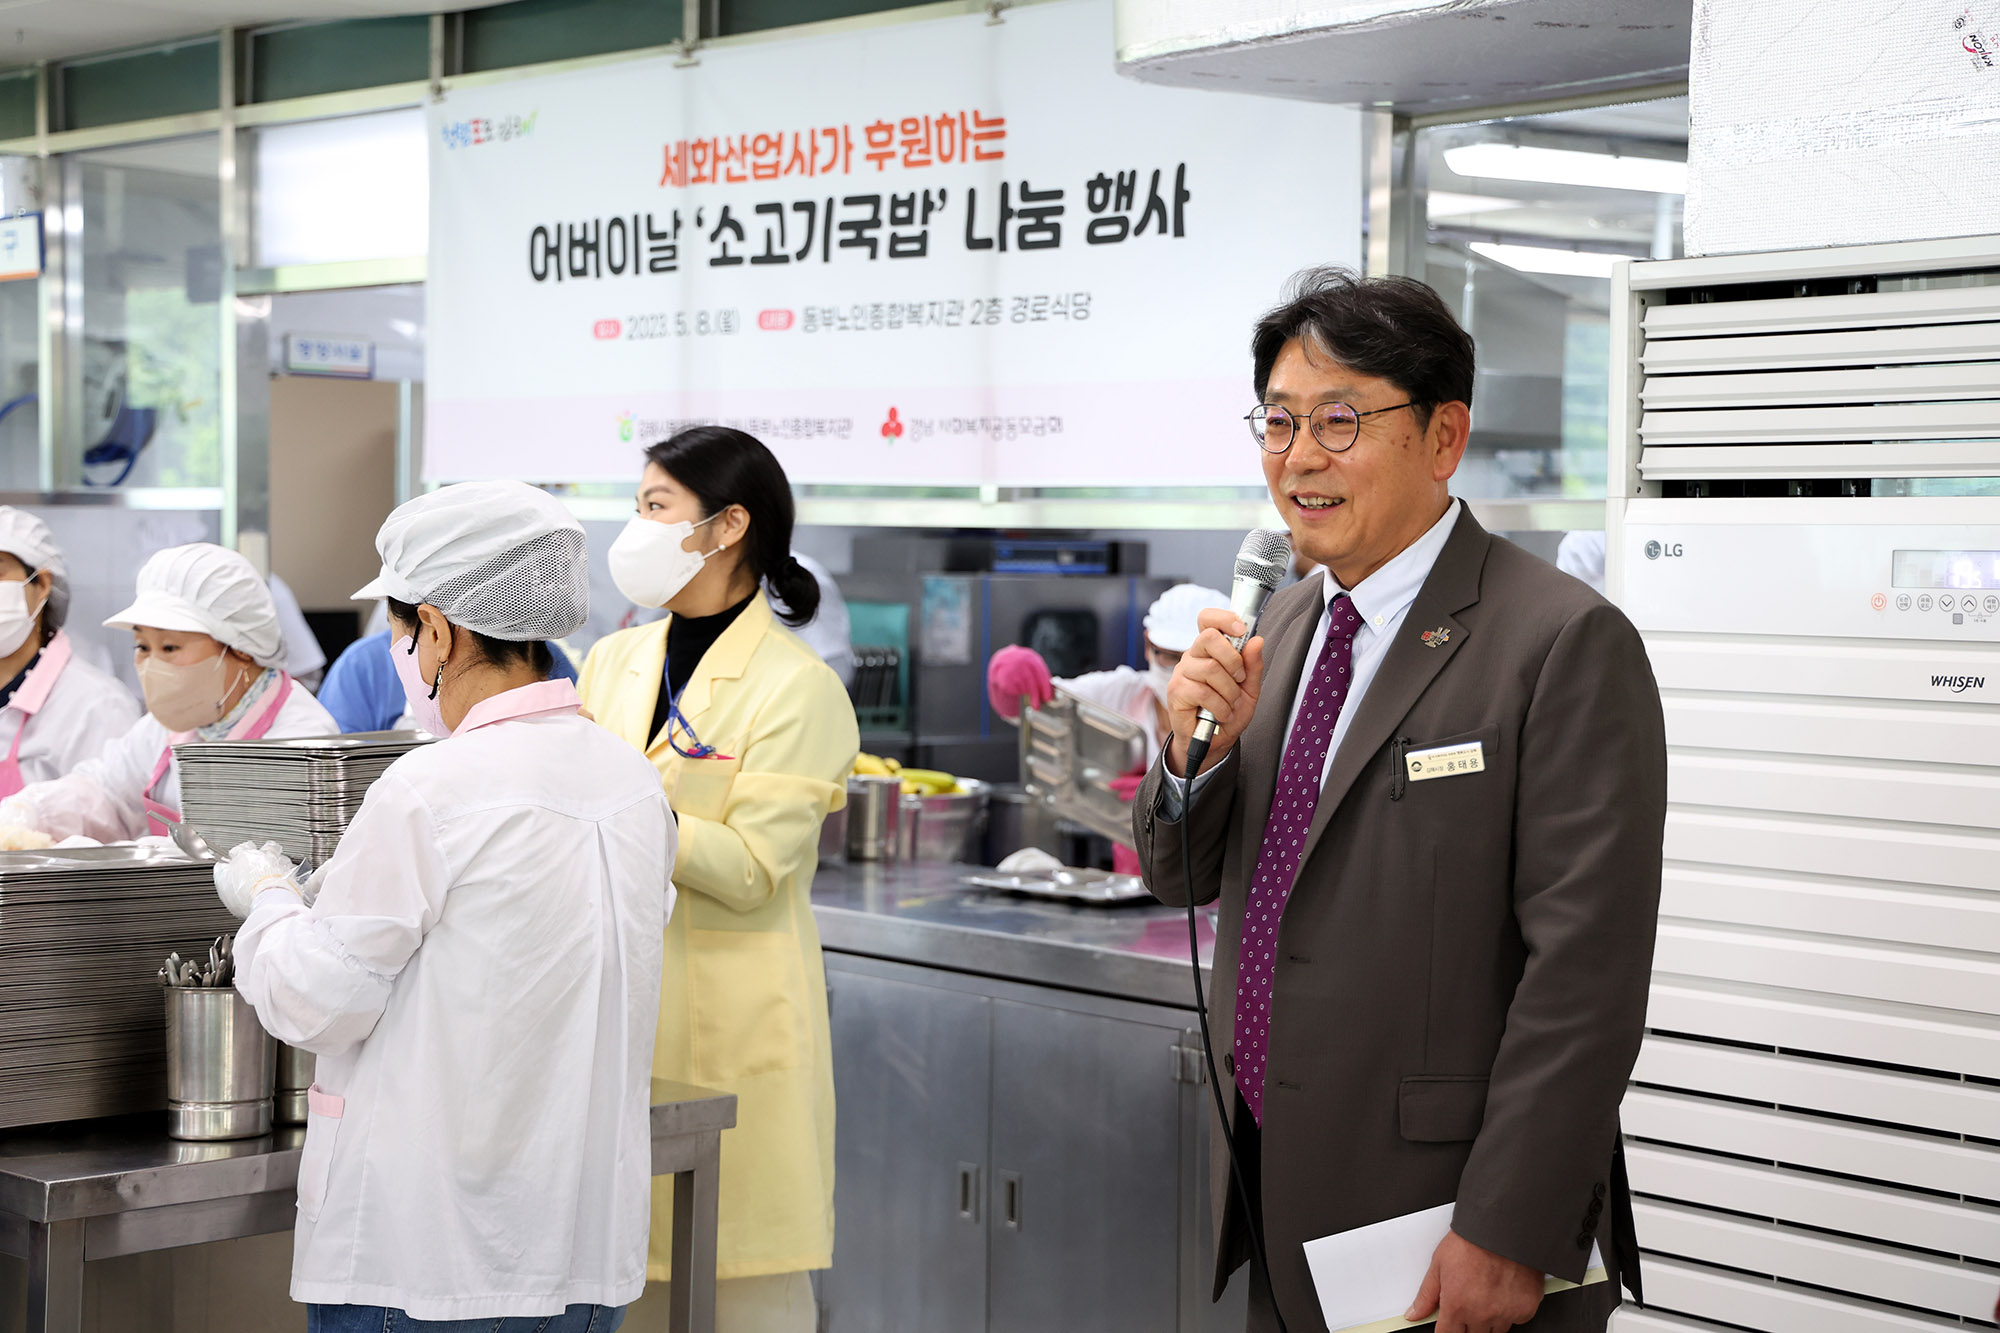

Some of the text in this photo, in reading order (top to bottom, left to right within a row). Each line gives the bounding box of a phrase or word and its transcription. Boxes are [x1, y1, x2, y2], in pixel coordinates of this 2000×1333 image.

[659, 109, 1006, 188] 세화산업사가 후원하는
[529, 208, 683, 282] 어버이날
[965, 179, 1065, 253] 나눔
[1086, 162, 1191, 245] 행사
[802, 299, 965, 334] 동부노인종합복지관
[969, 297, 1003, 327] 2층
[1010, 291, 1092, 325] 경로식당
[1664, 543, 1683, 557] LG
[1931, 675, 1985, 693] WHISEN
